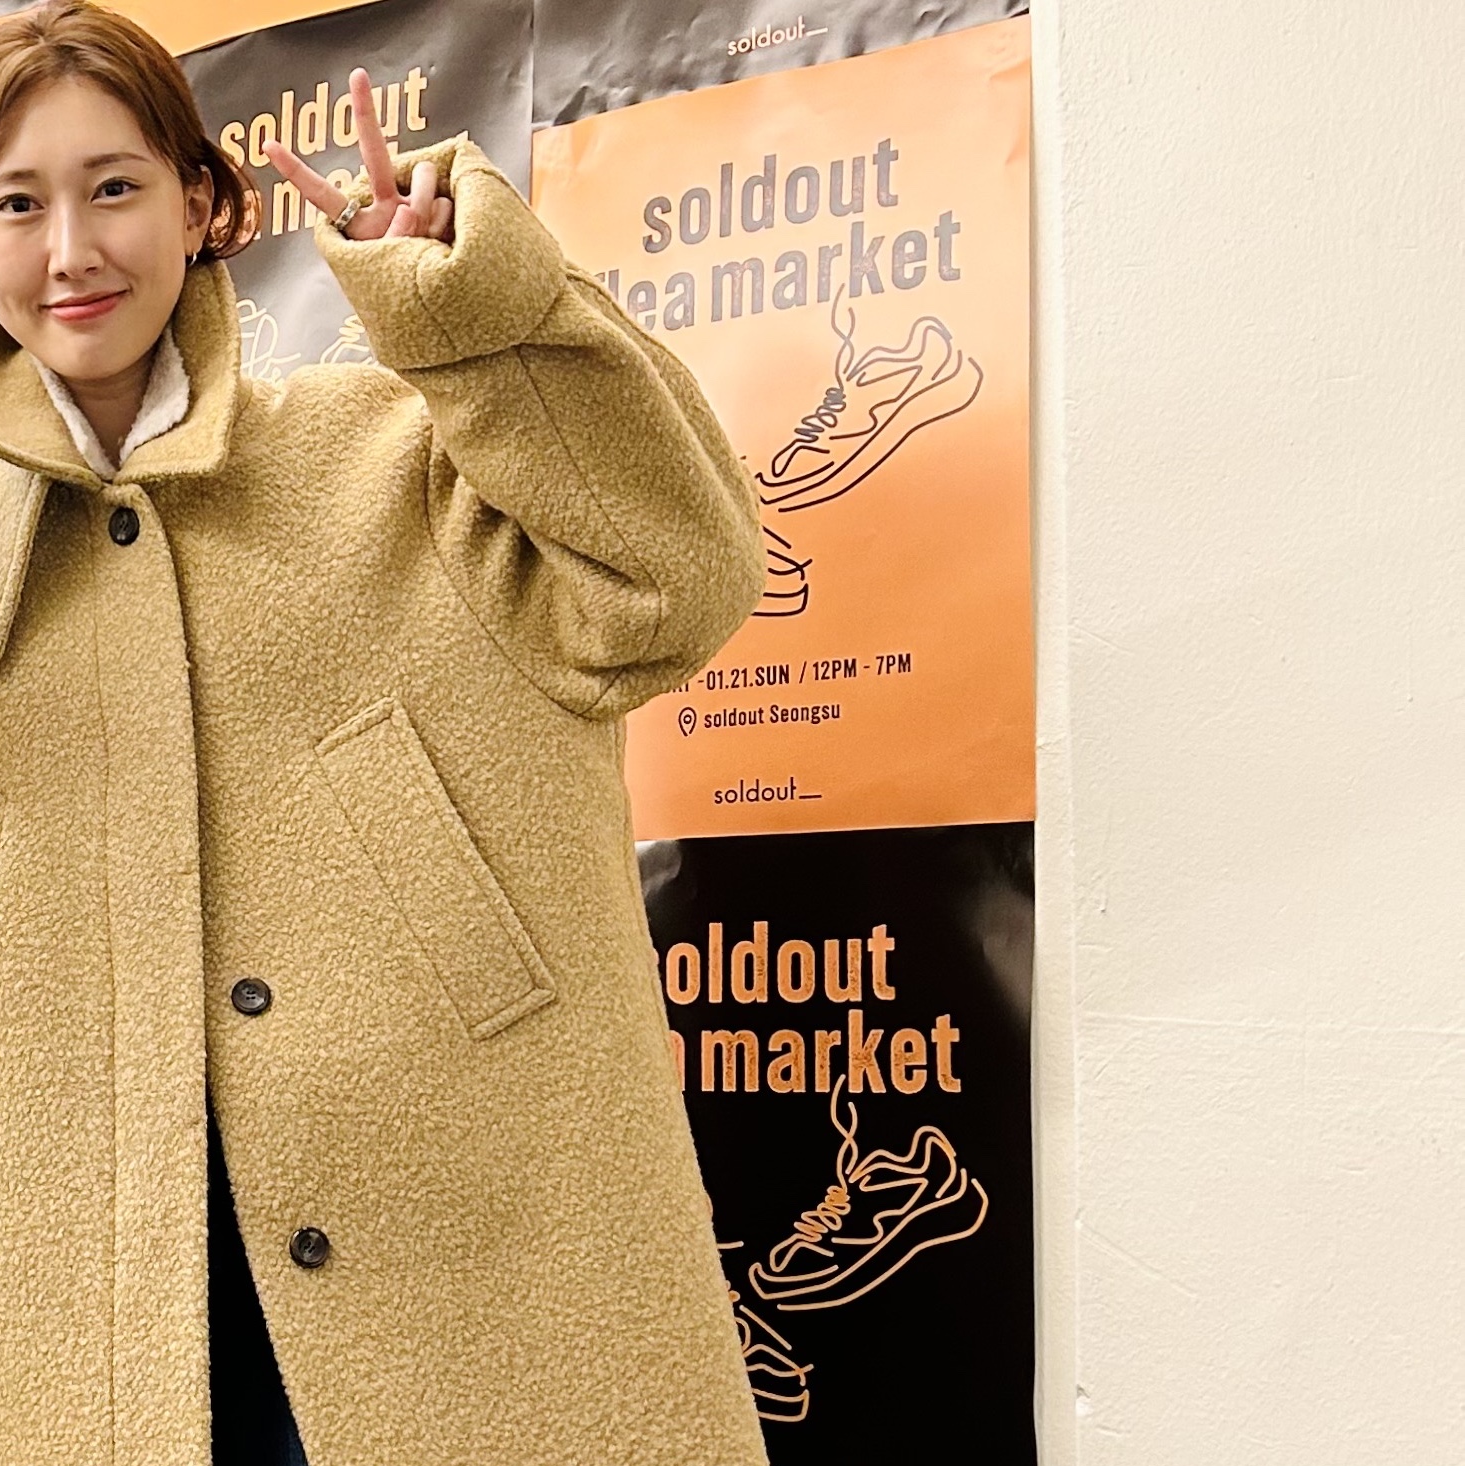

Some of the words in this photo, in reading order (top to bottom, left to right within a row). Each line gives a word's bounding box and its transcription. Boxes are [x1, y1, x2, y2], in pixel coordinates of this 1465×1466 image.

[642, 138, 898, 254] soldout
[711, 210, 961, 322] market
[812, 658, 857, 681] 12PM
[875, 653, 912, 675] 7PM
[704, 707, 764, 729] soldout
[769, 703, 841, 725] Seongsu
[653, 921, 896, 1005] oldout
[701, 1009, 962, 1094] market
